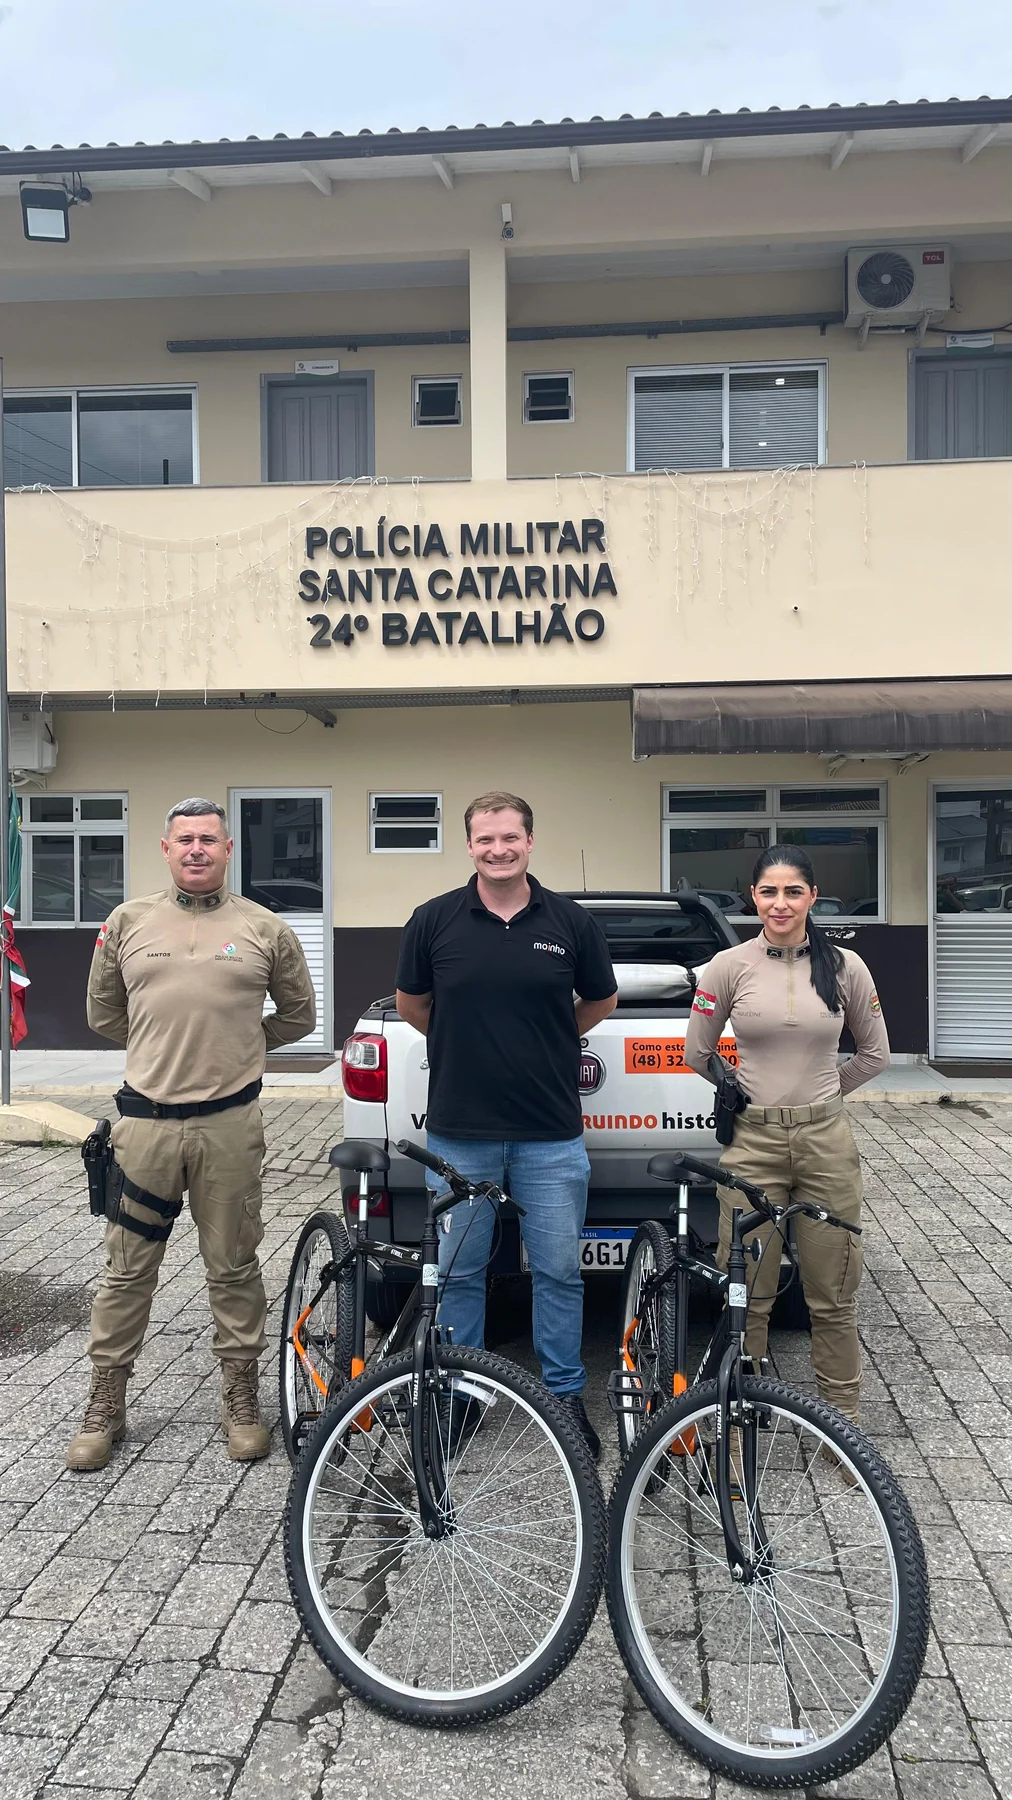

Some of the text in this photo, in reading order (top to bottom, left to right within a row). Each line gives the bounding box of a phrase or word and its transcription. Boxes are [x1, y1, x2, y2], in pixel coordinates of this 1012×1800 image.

[306, 516, 606, 559] POLÍCIA MILITAR
[298, 562, 618, 602] SANTA CATARINA
[381, 602, 605, 646] BATALHÃO
[533, 942, 565, 955] moinho
[632, 1042, 737, 1053] Como esto gind
[632, 1053, 661, 1068] (48)
[667, 1055, 686, 1067] 32
[580, 1065, 596, 1082] IAT
[582, 1114, 658, 1130] RUINDO
[662, 1112, 717, 1130] histó
[581, 1242, 626, 1266] 6G1
